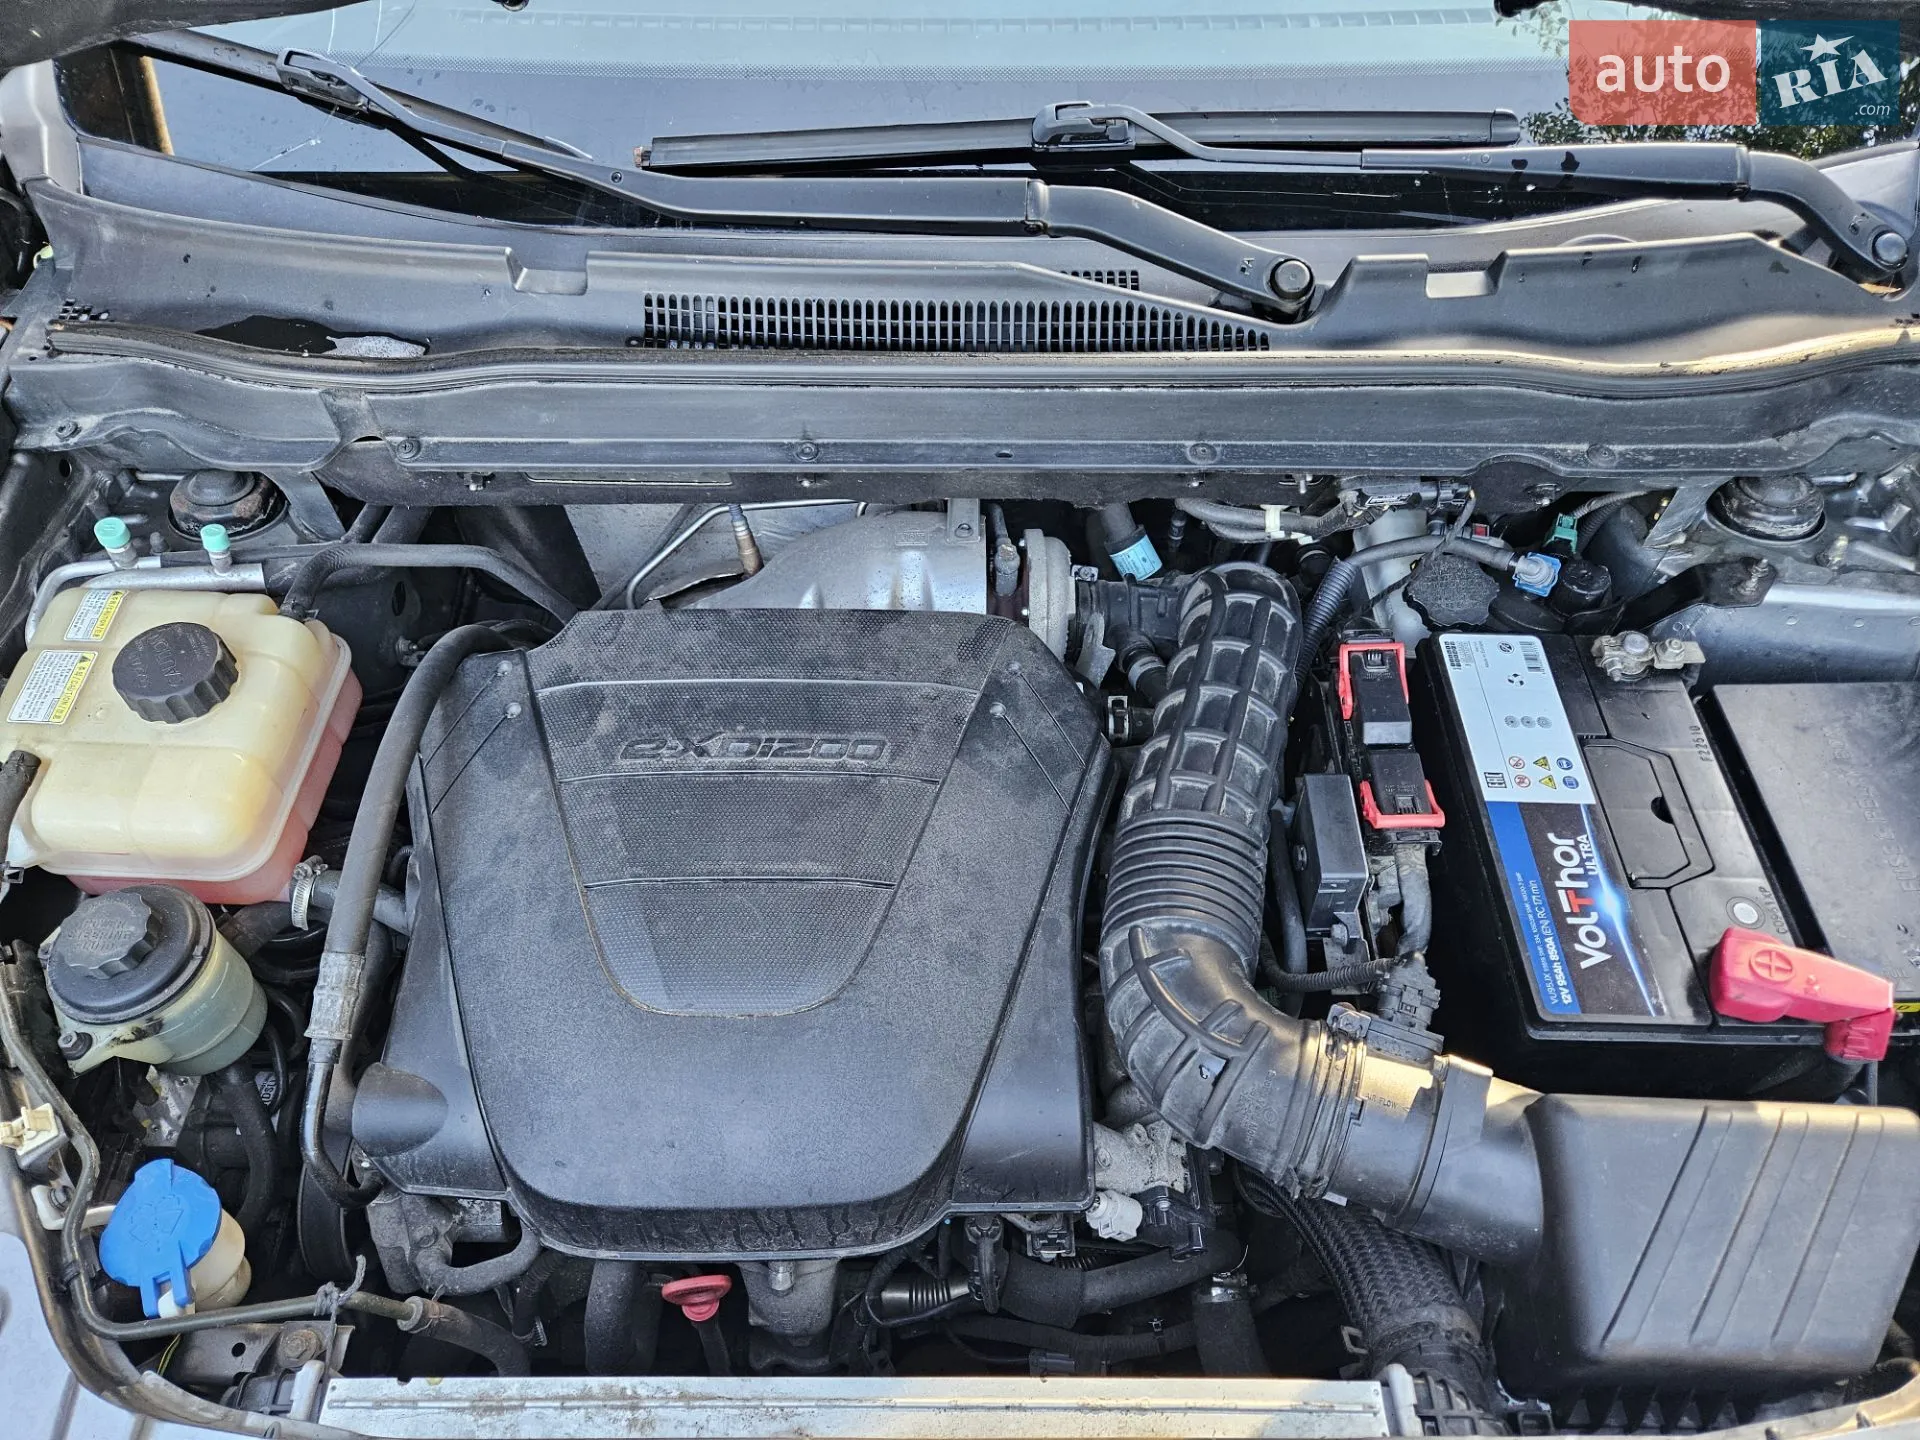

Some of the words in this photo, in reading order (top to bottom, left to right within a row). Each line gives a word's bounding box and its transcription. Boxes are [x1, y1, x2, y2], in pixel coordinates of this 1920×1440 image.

[1577, 834, 1600, 876] ULTRA
[1529, 880, 1540, 896] min
[1536, 905, 1548, 919] RC
[1545, 936, 1560, 962] 850A
[1552, 962, 1568, 988] 95Ah
[1543, 973, 1559, 1005] VU95JX
[1559, 987, 1573, 1005] 12V
[1380, 1097, 1398, 1109] FLOW
